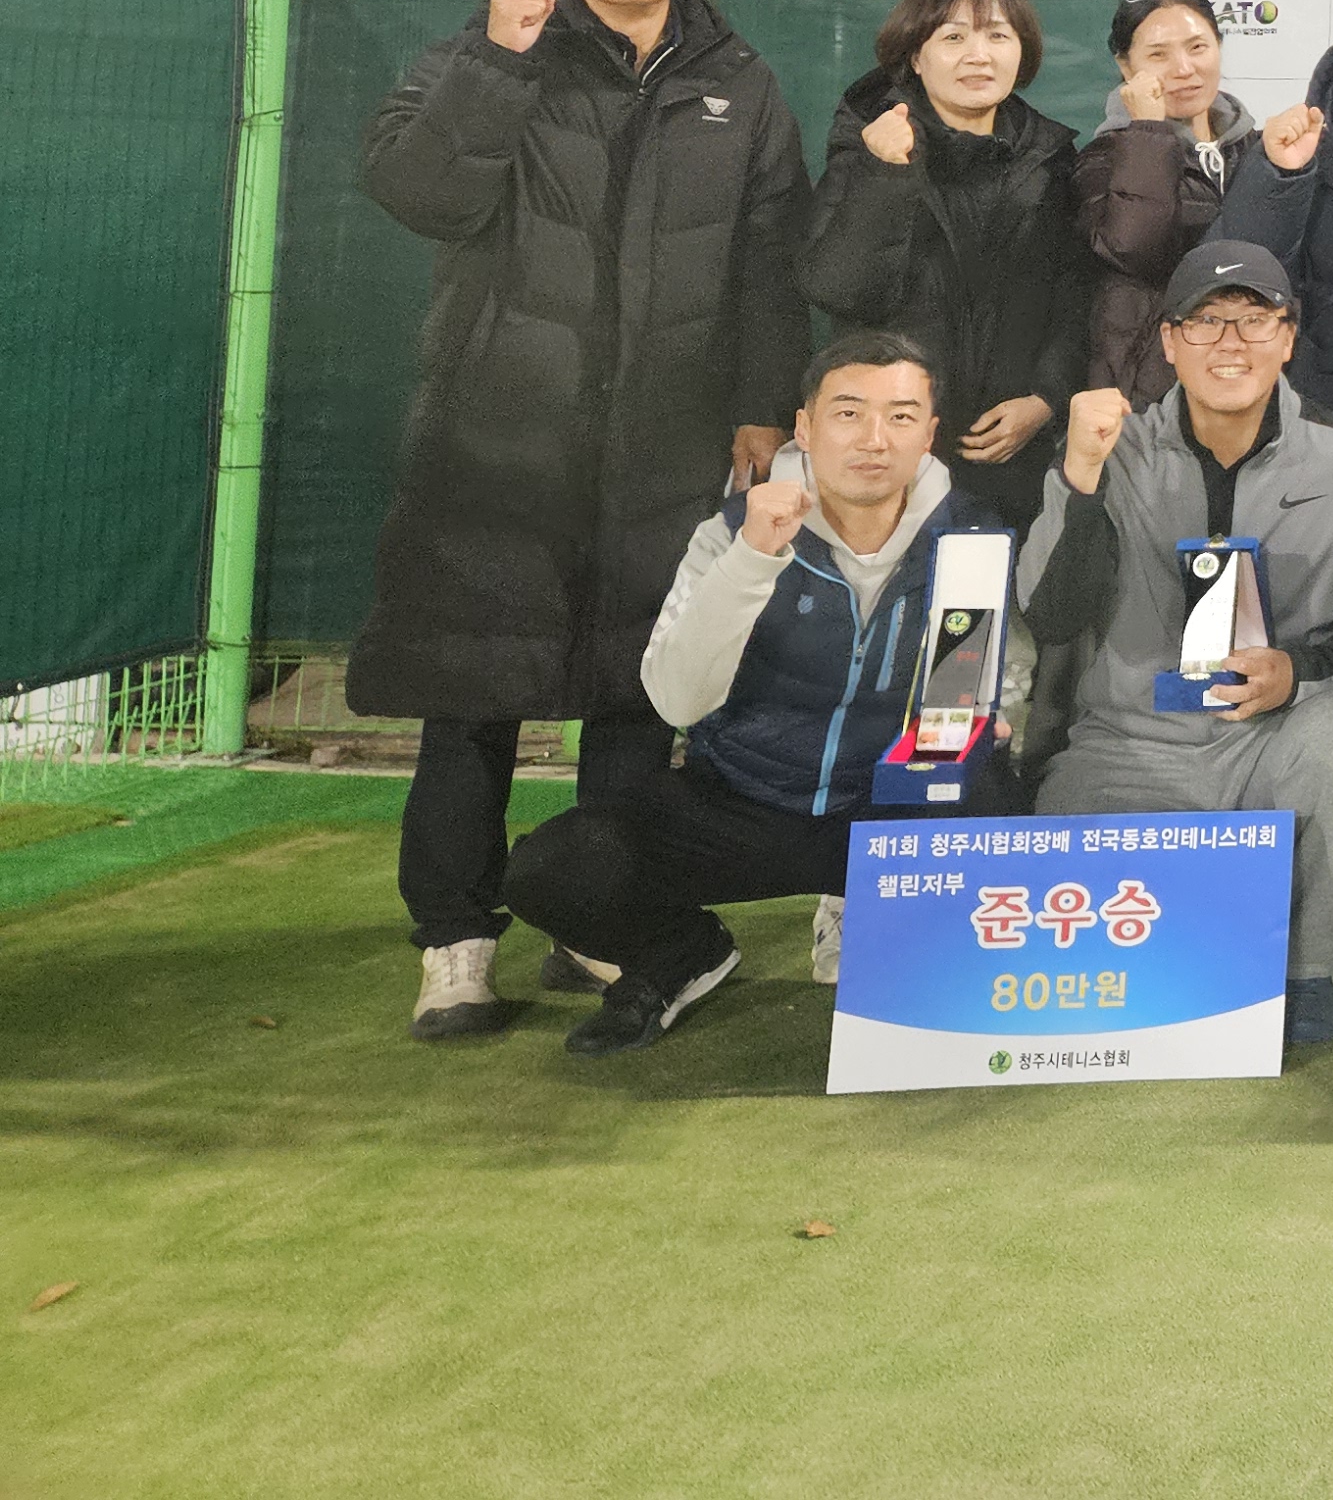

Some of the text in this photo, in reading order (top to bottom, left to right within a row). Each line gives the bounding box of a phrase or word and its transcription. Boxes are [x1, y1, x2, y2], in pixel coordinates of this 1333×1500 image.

[1211, 1, 1278, 25] ATO
[867, 824, 1276, 859] 제1회 청주시협회장배 전국동호인테니스대회
[877, 872, 965, 899] 챌린저부
[971, 880, 1161, 948] 준우승
[990, 971, 1128, 1013] 80만원
[1018, 1049, 1131, 1071] 청주시테니스협회
